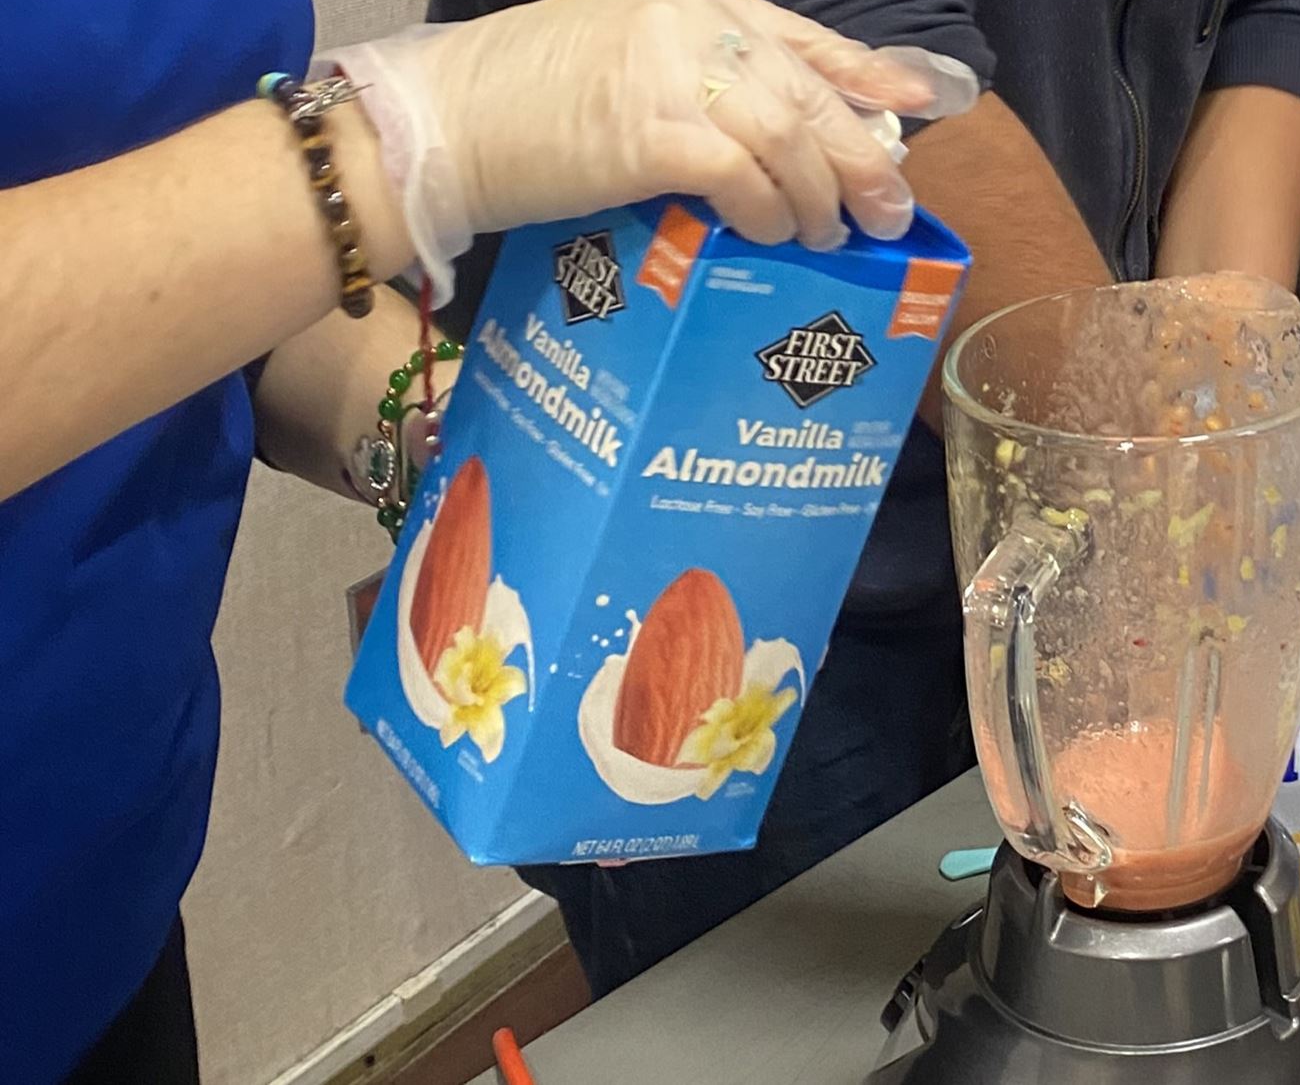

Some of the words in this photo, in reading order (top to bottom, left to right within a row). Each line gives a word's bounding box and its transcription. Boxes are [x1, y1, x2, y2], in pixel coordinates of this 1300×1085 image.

[569, 234, 622, 292] FIRST
[555, 258, 618, 322] STREET
[524, 313, 591, 390] Vanilla
[763, 353, 863, 388] STREET
[785, 331, 863, 361] FIRST
[477, 318, 623, 468] Almondmilk
[737, 418, 844, 449] Vanilla
[641, 446, 886, 488] Almondmilk
